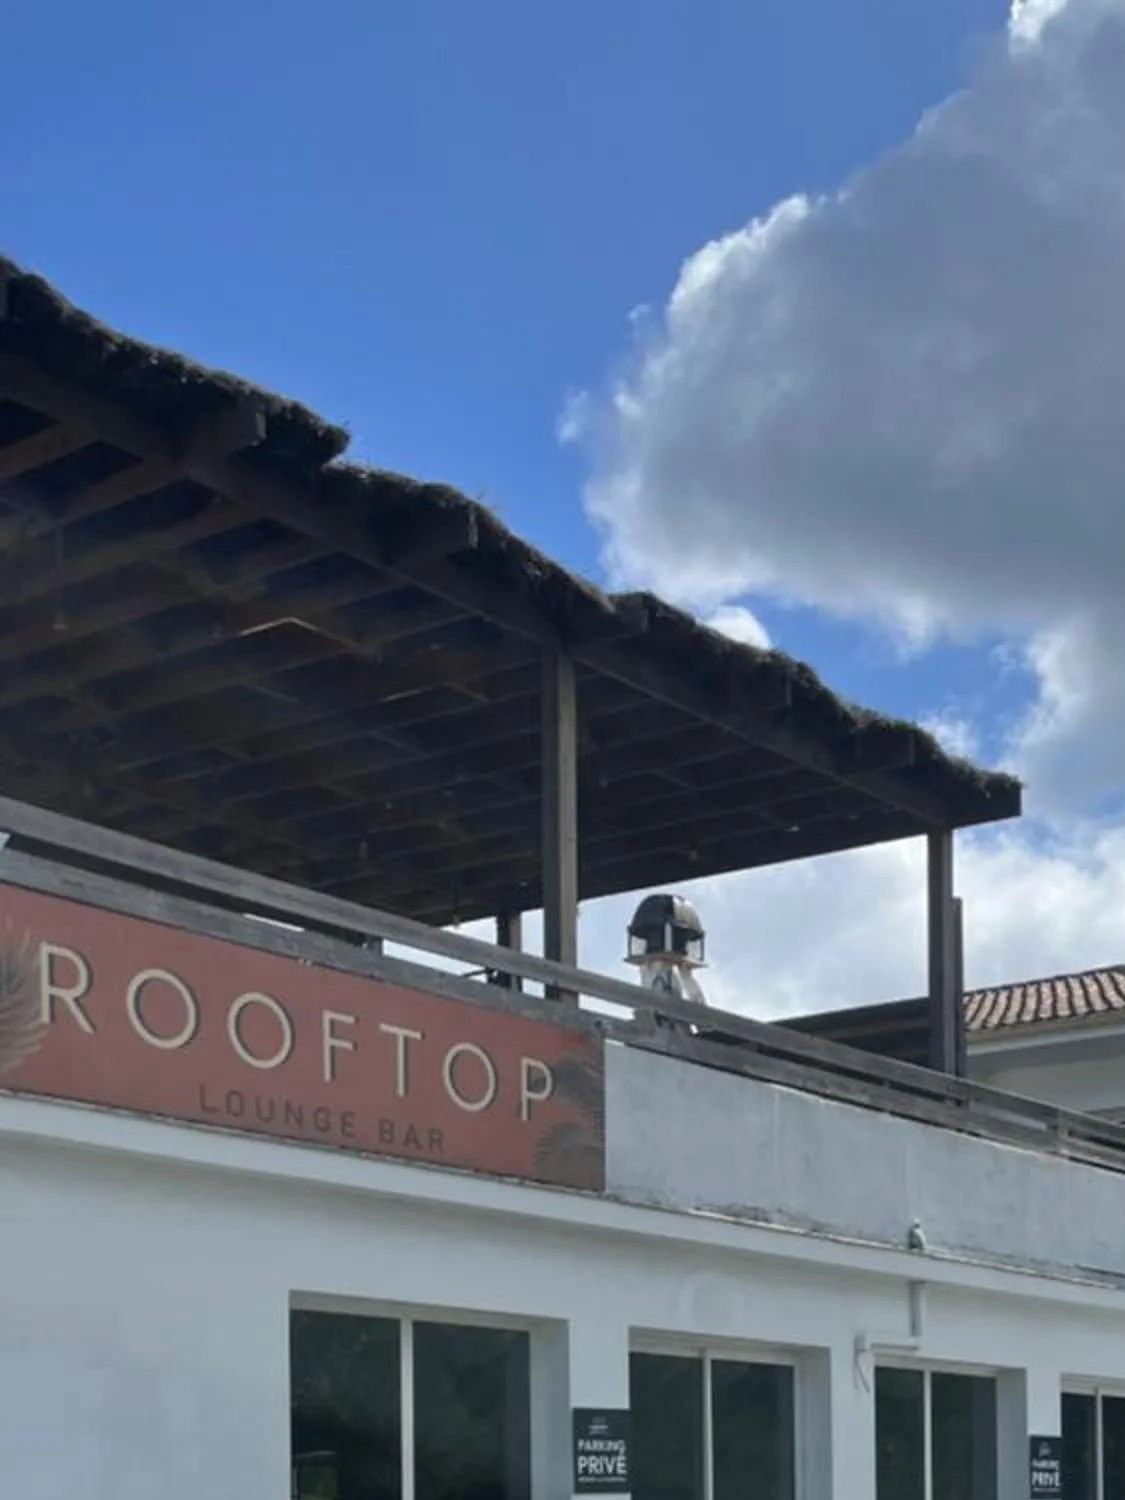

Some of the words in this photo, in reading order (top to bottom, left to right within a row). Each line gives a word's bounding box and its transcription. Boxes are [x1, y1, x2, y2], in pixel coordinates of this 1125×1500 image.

[38, 940, 556, 1122] ROOFTOP
[200, 1085, 357, 1139] LOUNGE
[378, 1117, 445, 1153] BAR
